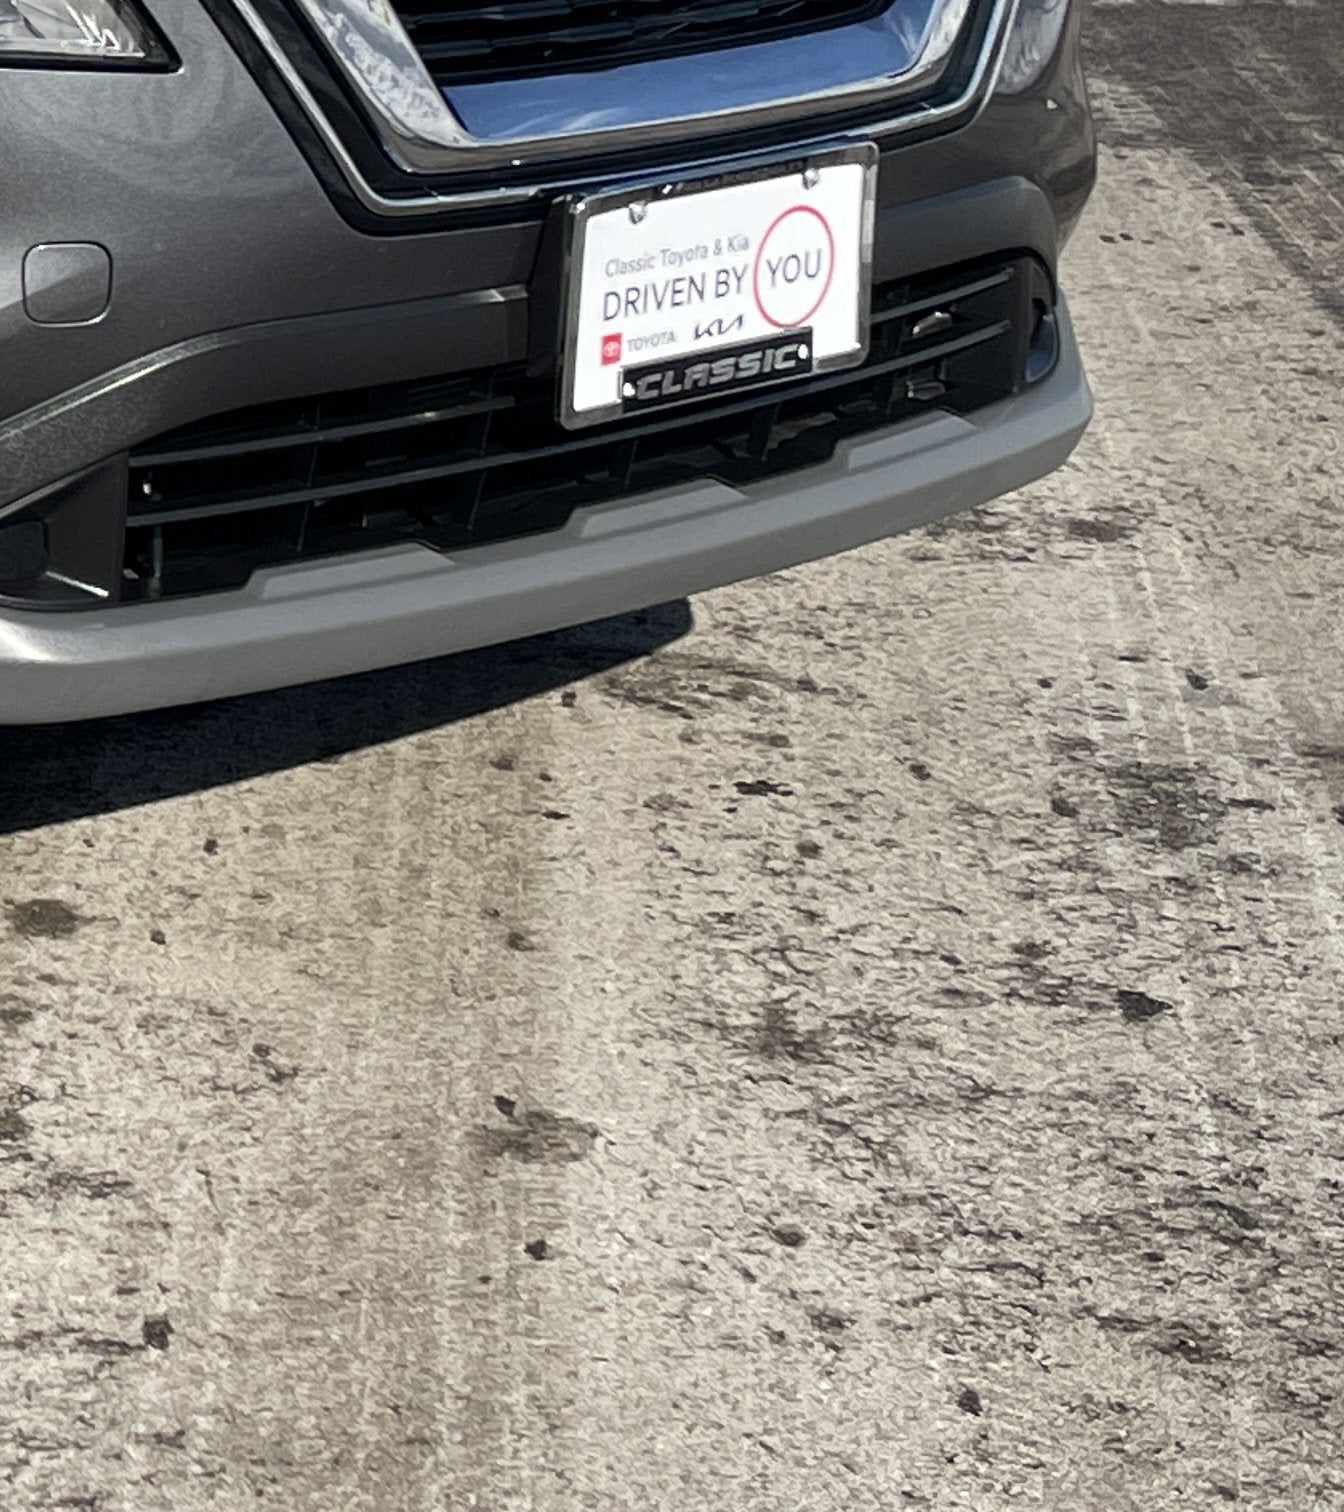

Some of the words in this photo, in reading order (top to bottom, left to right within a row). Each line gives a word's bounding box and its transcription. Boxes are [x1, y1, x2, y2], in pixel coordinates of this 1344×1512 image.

[605, 255, 656, 277] Classic
[660, 245, 708, 268] Toyota
[713, 239, 722, 256] &
[727, 235, 749, 252] Kia
[602, 272, 706, 321] DRIVEN
[714, 263, 748, 299] BY
[766, 248, 822, 288] YOU
[627, 331, 677, 353] TOYOTA
[636, 344, 799, 400] CLASSIC
